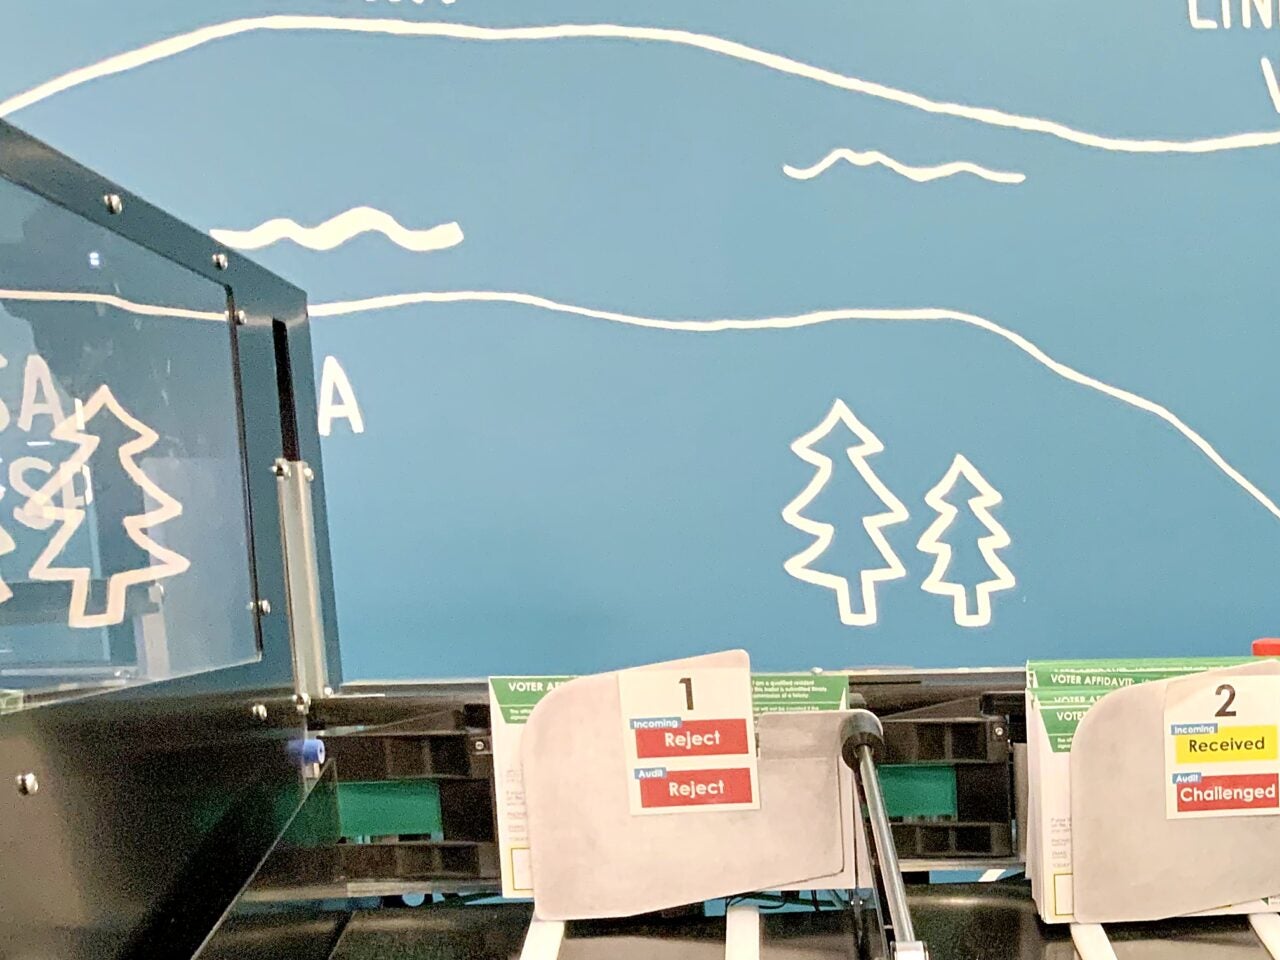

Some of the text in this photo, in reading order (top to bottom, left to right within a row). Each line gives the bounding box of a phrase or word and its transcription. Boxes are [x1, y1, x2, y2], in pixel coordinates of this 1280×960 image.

[508, 681, 544, 692] VOTER
[1051, 673, 1082, 685] VOTER
[679, 677, 694, 710] 1
[1214, 684, 1237, 717] 2
[633, 719, 678, 729] Incoming
[1174, 724, 1215, 734] Incoming
[664, 730, 721, 749] Reject
[1189, 736, 1265, 753] Received
[668, 779, 725, 799] Reject
[1180, 784, 1276, 802] Challenged
